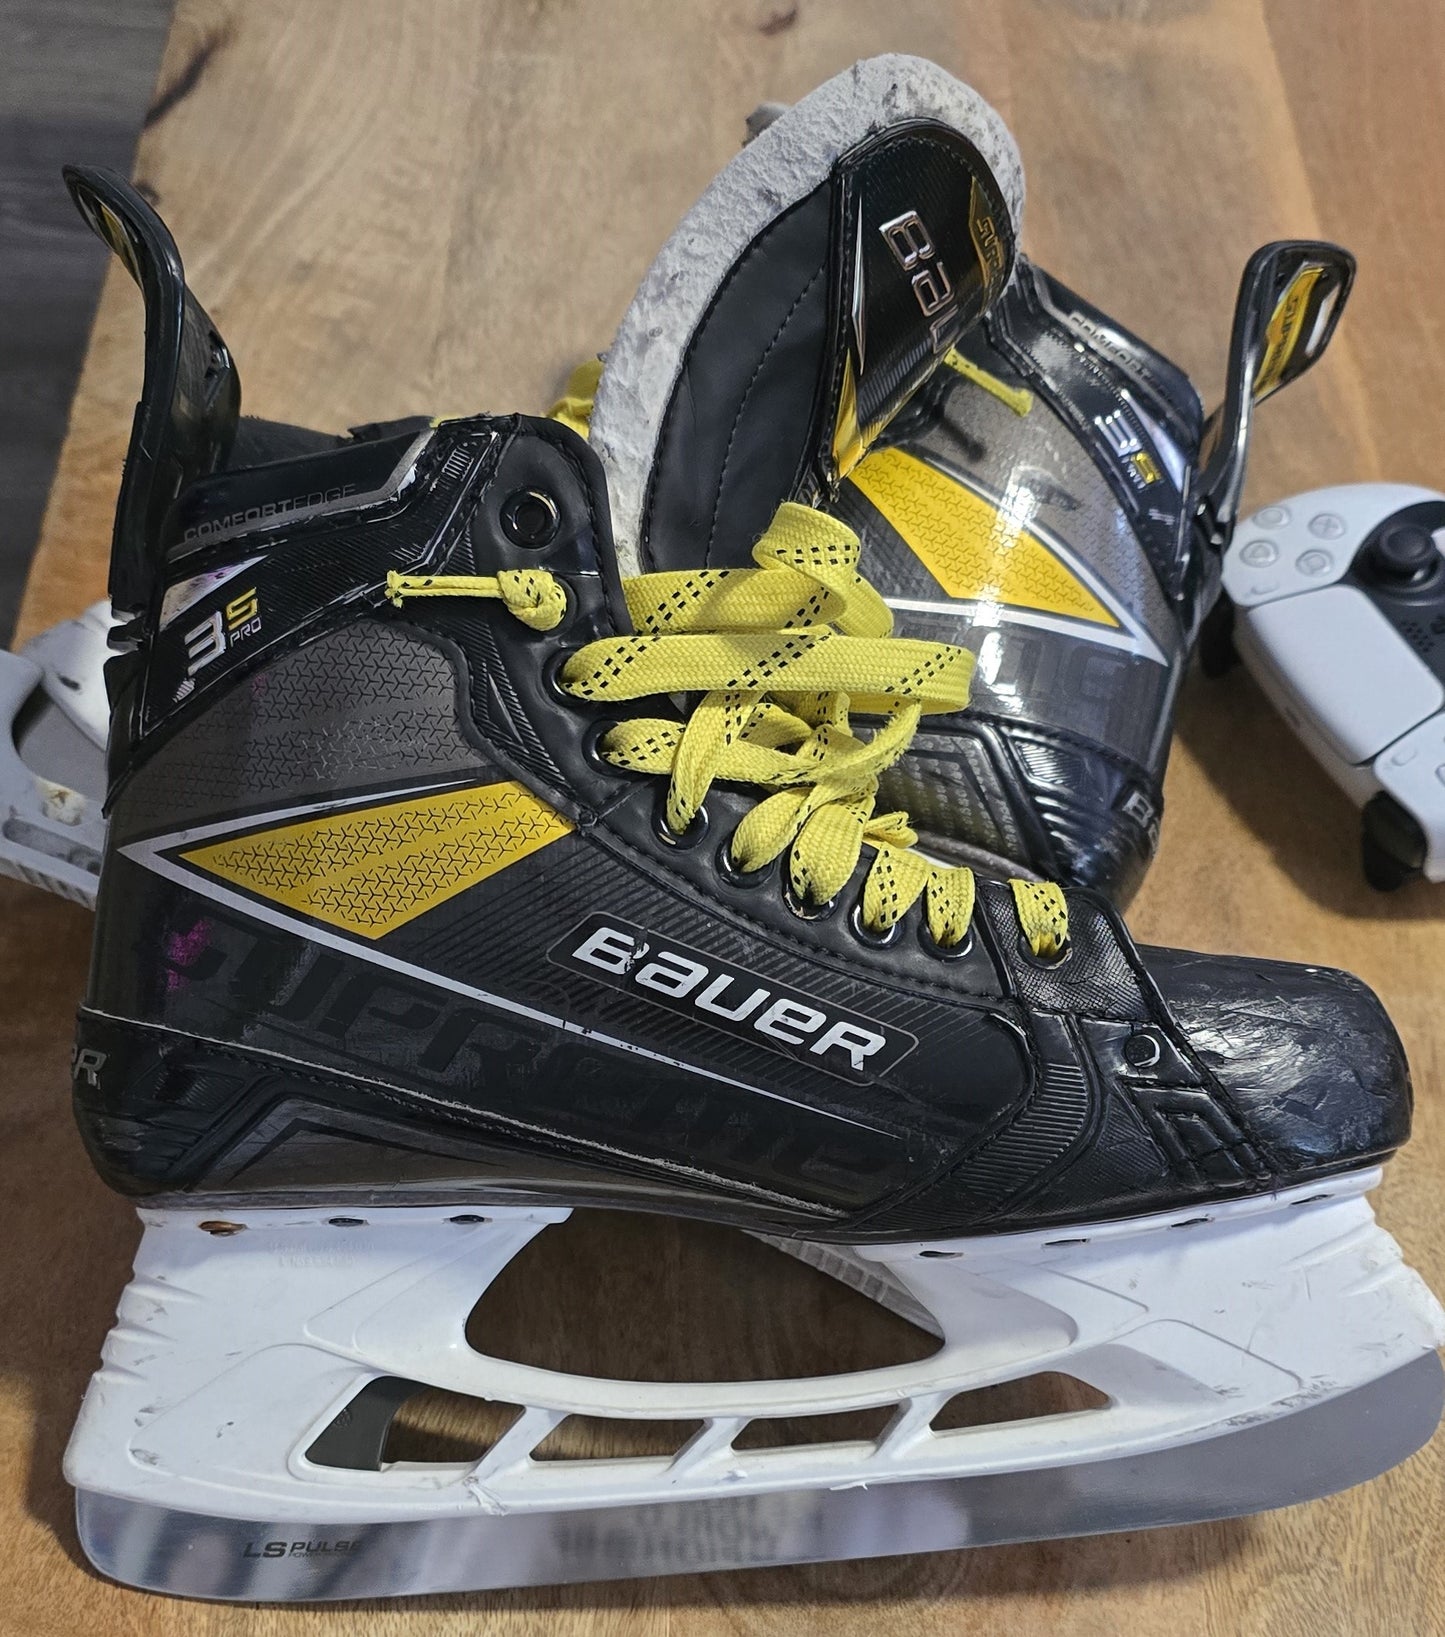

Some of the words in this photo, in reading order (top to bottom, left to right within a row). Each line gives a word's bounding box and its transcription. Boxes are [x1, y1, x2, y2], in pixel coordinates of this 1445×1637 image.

[184, 483, 356, 543] COMFORTEDGE
[229, 616, 262, 648] PRO
[243, 1541, 287, 1558] LS
